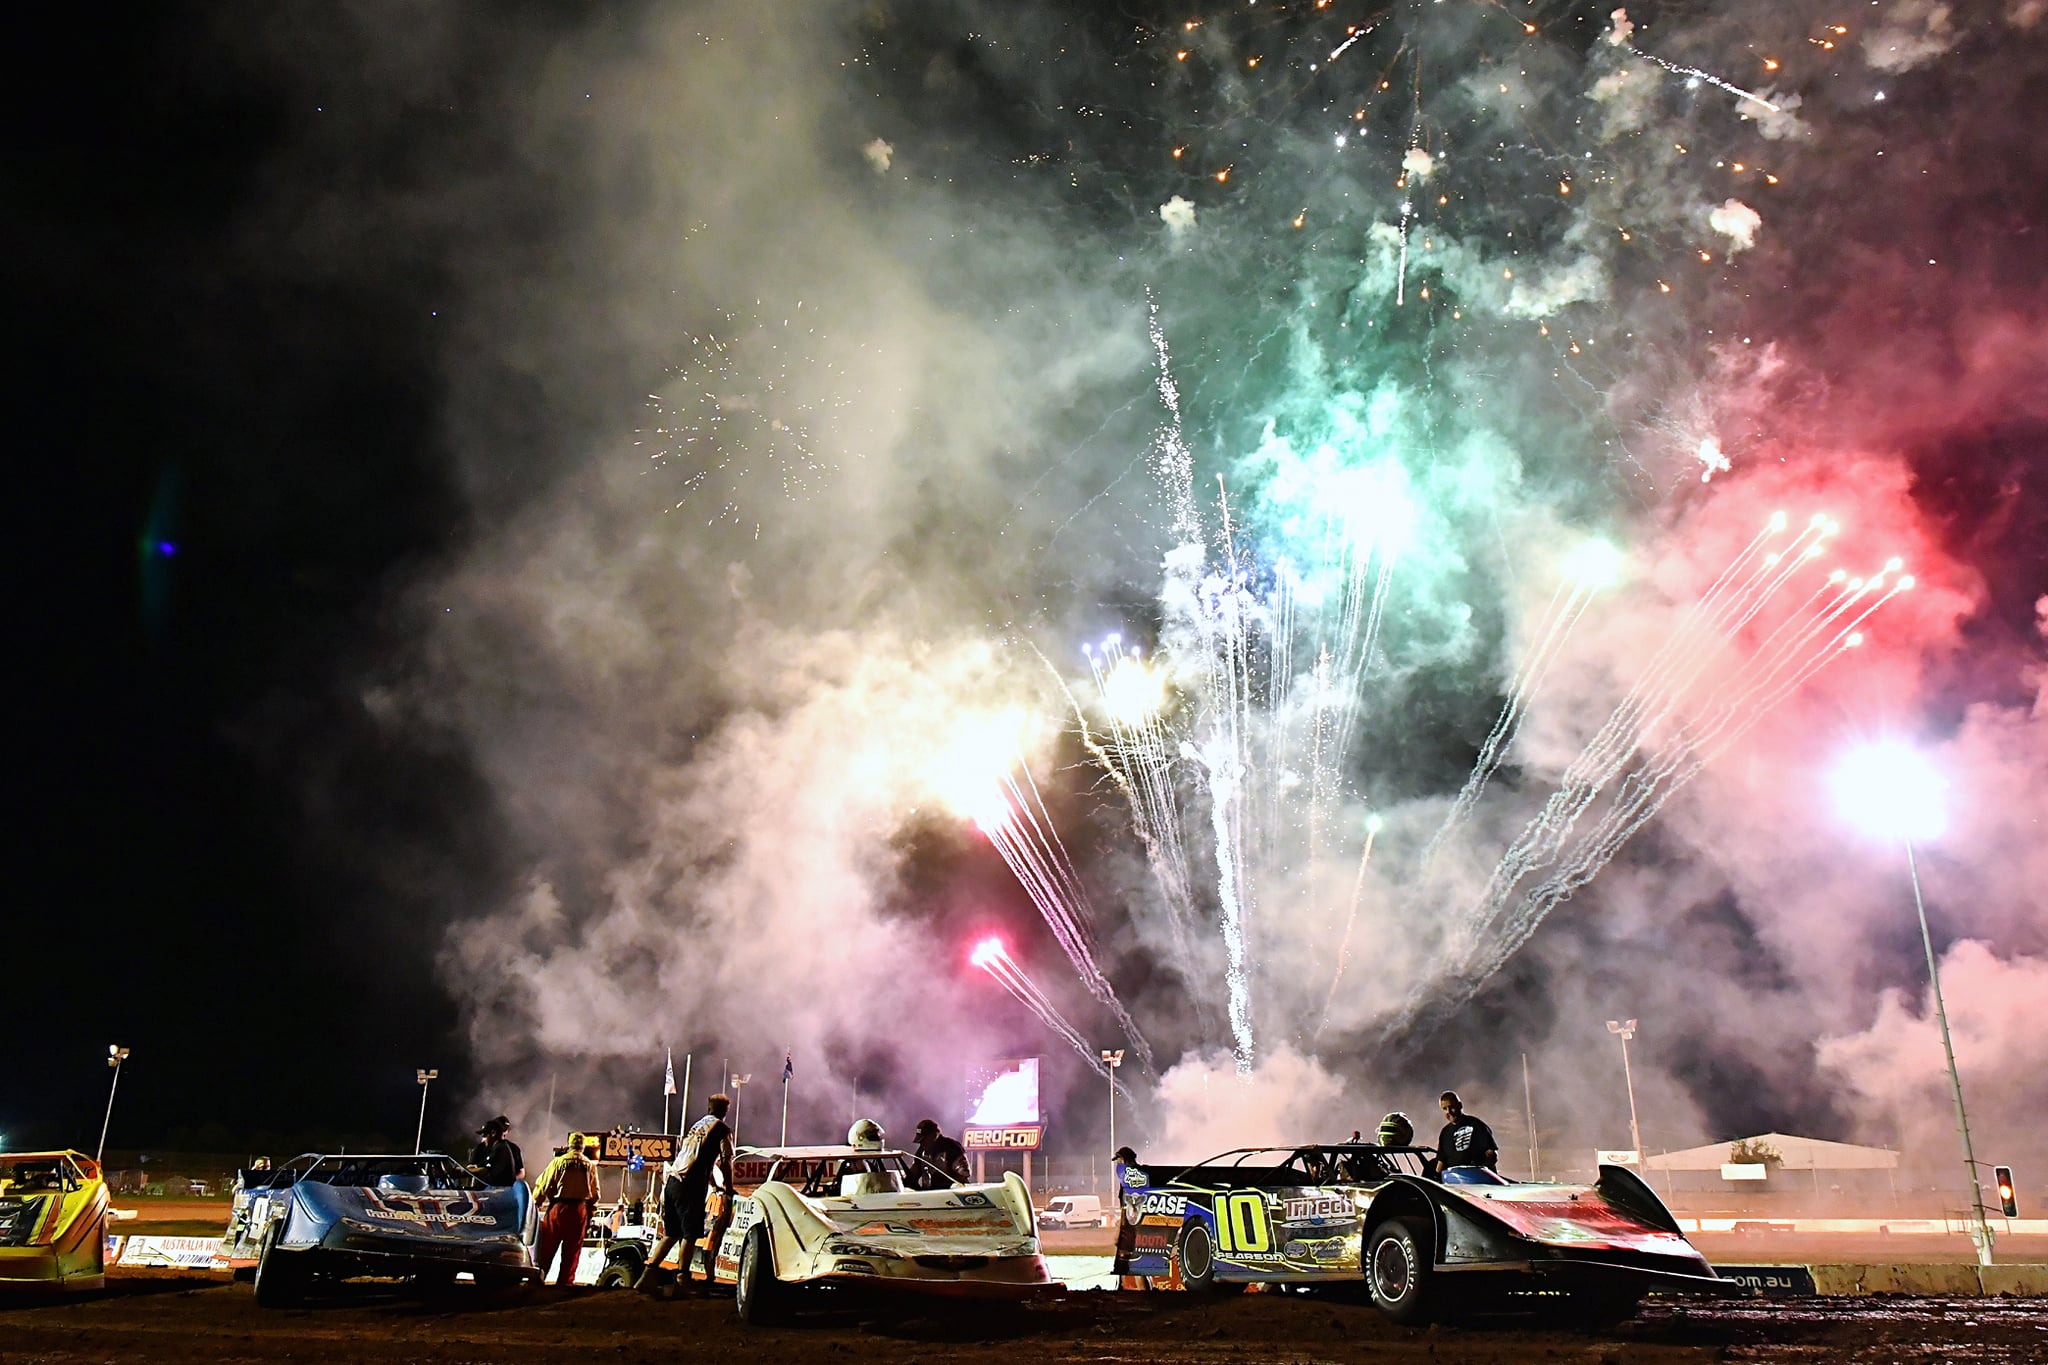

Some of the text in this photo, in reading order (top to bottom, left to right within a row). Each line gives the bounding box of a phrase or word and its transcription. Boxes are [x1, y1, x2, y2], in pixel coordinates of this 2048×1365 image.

[964, 1129, 1039, 1147] AEROFLOW
[734, 1161, 837, 1178] SHETMETAL
[1147, 1195, 1188, 1214] CASE
[1214, 1194, 1269, 1252] 10
[160, 1239, 223, 1251] AUSTRALIA WID
[1216, 1251, 1286, 1262] PEARSON
